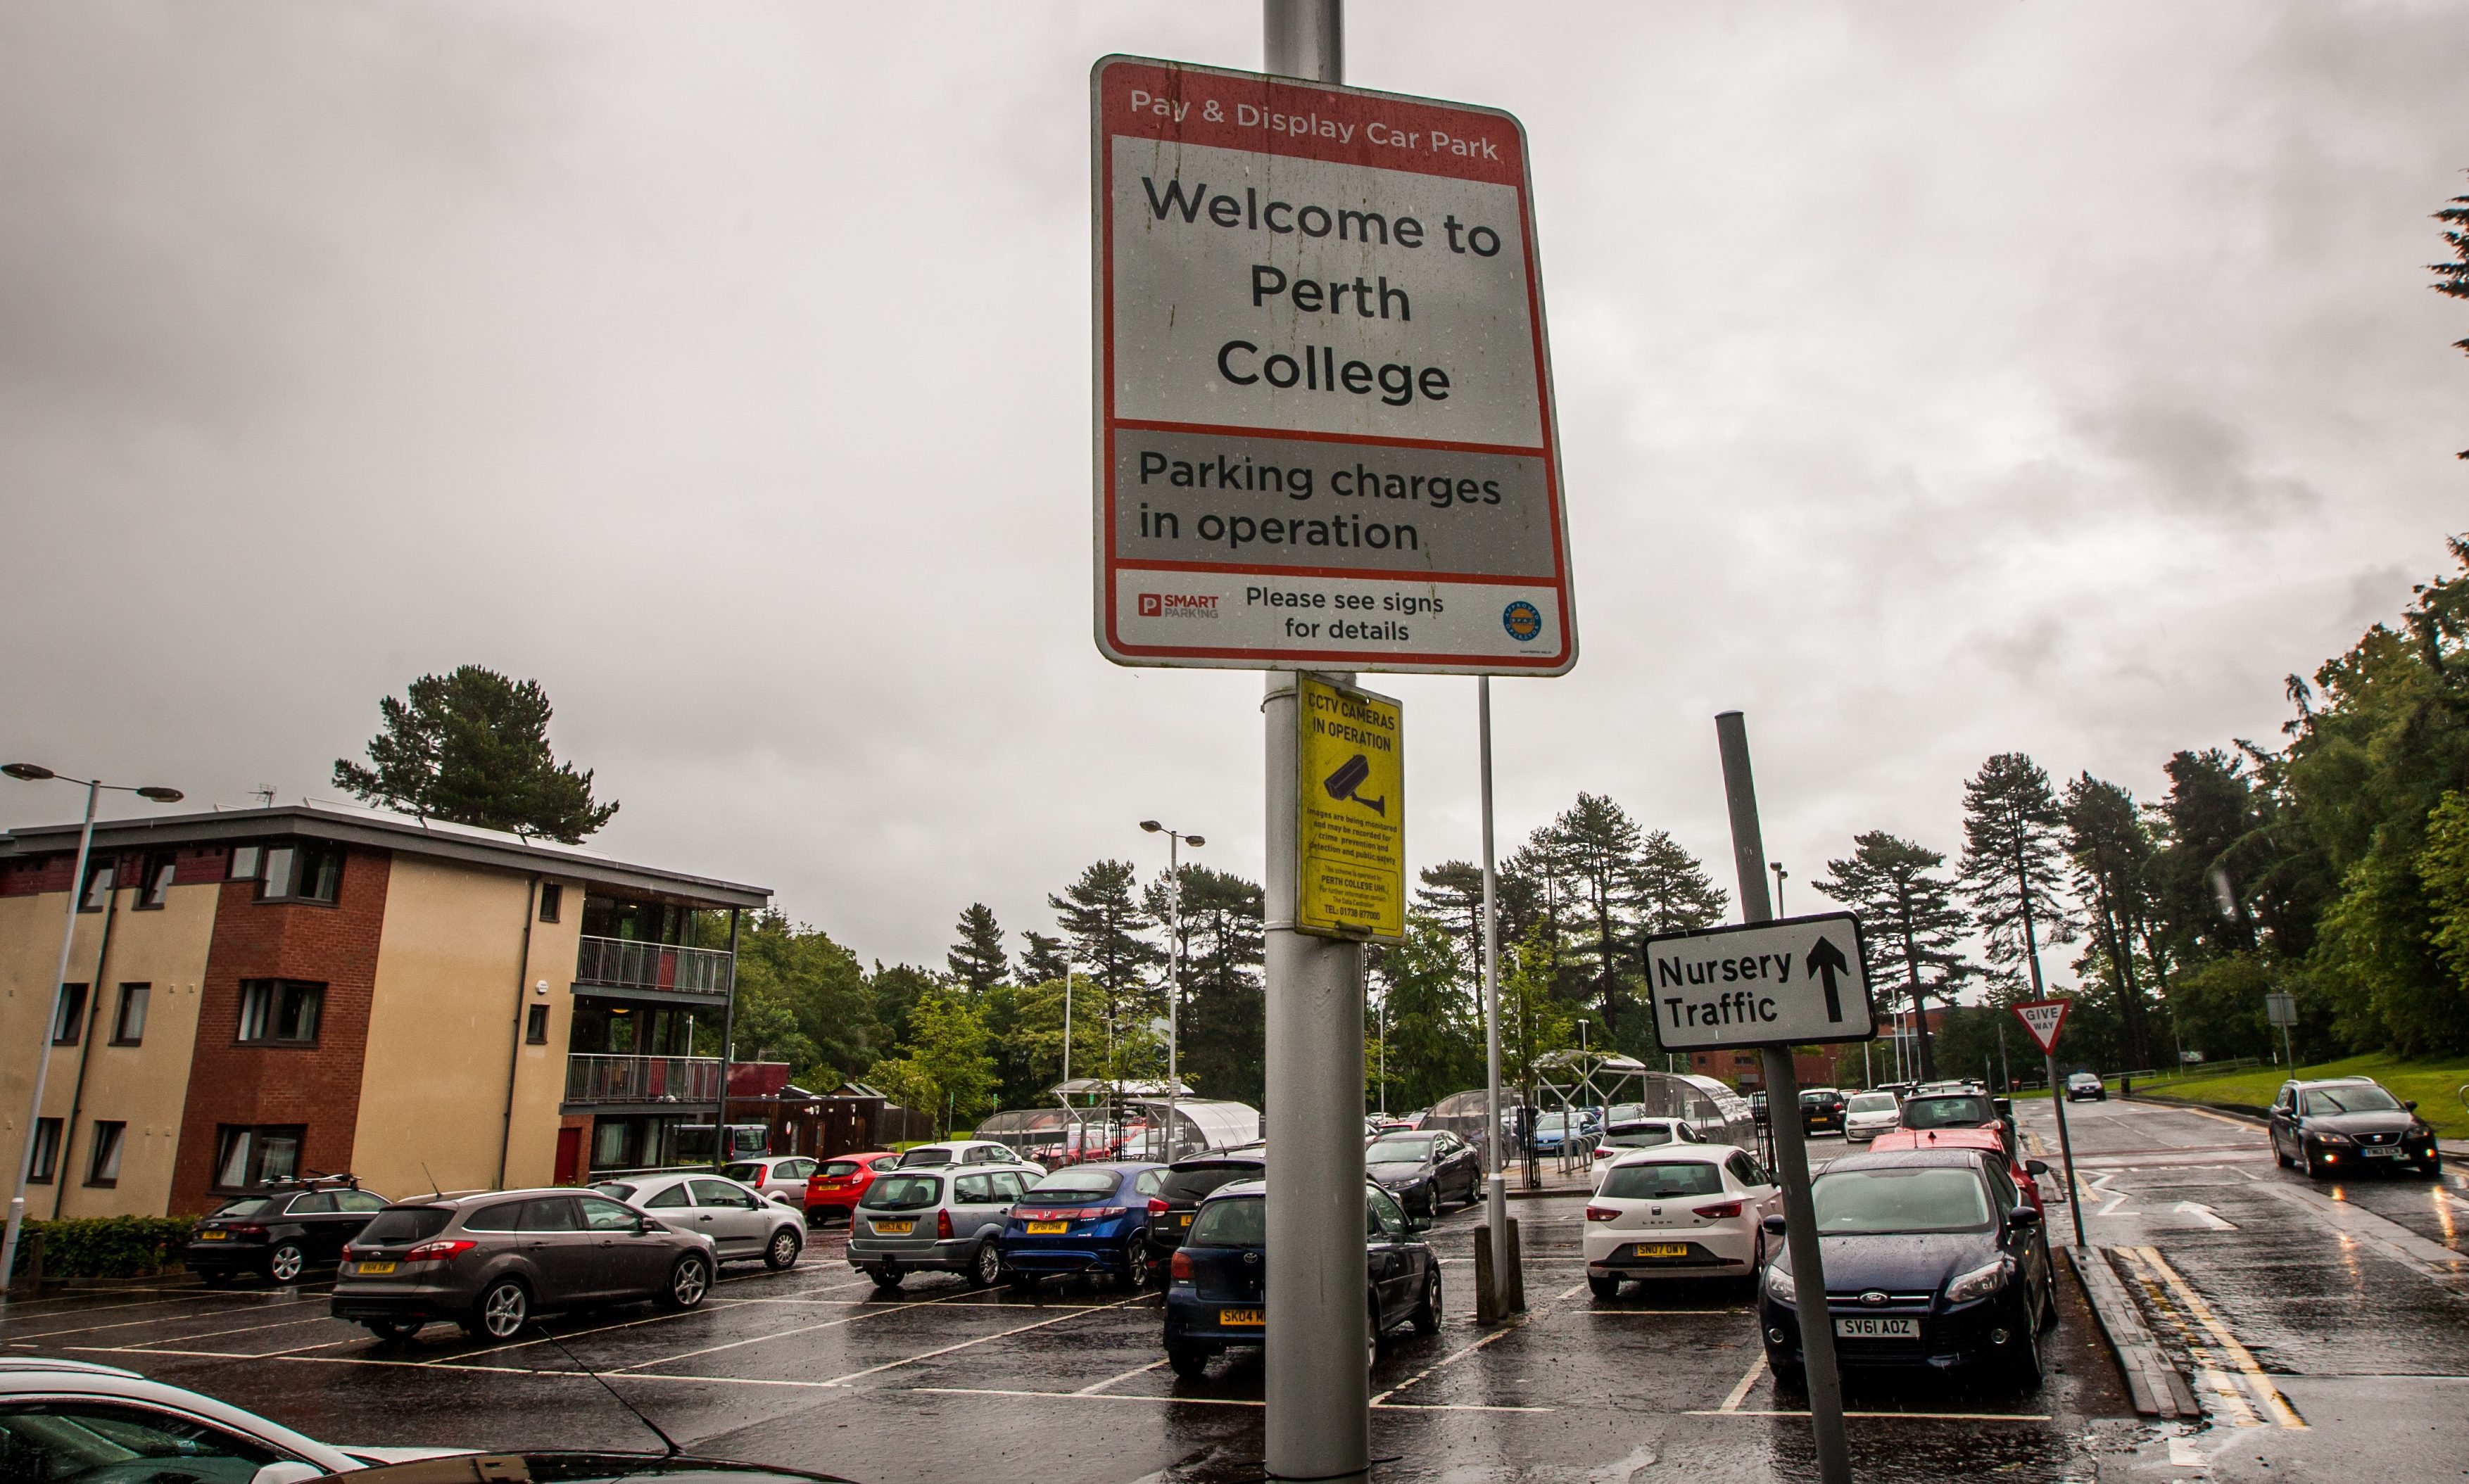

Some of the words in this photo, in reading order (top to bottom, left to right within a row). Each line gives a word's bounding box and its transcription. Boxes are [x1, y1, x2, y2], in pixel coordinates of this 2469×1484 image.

[1131, 90, 1189, 123] Pay
[1203, 100, 1225, 123] &
[1237, 103, 1356, 144] Display
[1366, 122, 1420, 150] Car
[1432, 132, 1499, 160] Park
[1142, 177, 1424, 249] Welcome
[1444, 215, 1501, 258] to
[1252, 265, 1412, 322] Perth
[1218, 341, 1451, 406] College
[1141, 451, 1313, 501] Parking
[1331, 463, 1502, 507] charges
[1141, 503, 1180, 540] in
[1197, 514, 1418, 550] operation
[1165, 595, 1219, 609] SMART
[1246, 587, 1326, 613] Please
[1334, 592, 1375, 613] see
[1383, 592, 1444, 616] signs
[1165, 608, 1219, 619] PARKING
[1285, 618, 1319, 639] for
[1329, 619, 1410, 642] details
[1308, 692, 1339, 714] CCTV
[1341, 702, 1395, 730] CAMERAS
[1313, 717, 1325, 734] IN
[1328, 721, 1391, 752] OPERATION
[1307, 806, 1332, 818] Images
[1333, 813, 1344, 822] are
[1346, 814, 1364, 827] being
[1365, 821, 1397, 833] monitored
[1313, 820, 1326, 829] and
[1327, 823, 1342, 833] may
[1343, 825, 1351, 833] be
[1353, 828, 1381, 840] recorded
[1382, 832, 1392, 842] for
[1309, 841, 1341, 854] detection
[1318, 832, 1338, 842] crime
[1341, 837, 1376, 849] prevention
[1377, 844, 1389, 852] and
[1321, 875, 1343, 886] PERTH
[1344, 878, 1373, 891] COLLEGE
[1339, 907, 1358, 918] 01738
[1658, 953, 1791, 987] Nursery
[1665, 991, 1777, 1027] Traffic
[2026, 1007, 2058, 1020] GIVE
[2033, 1022, 2054, 1030] WAY
[878, 1222, 895, 1231] NH53
[896, 1222, 909, 1231] NLT
[1640, 1245, 1663, 1254] SN07
[1225, 1310, 1253, 1322] SK04
[1845, 1320, 1877, 1333] SV61
[1882, 1320, 1910, 1334] AOZ
